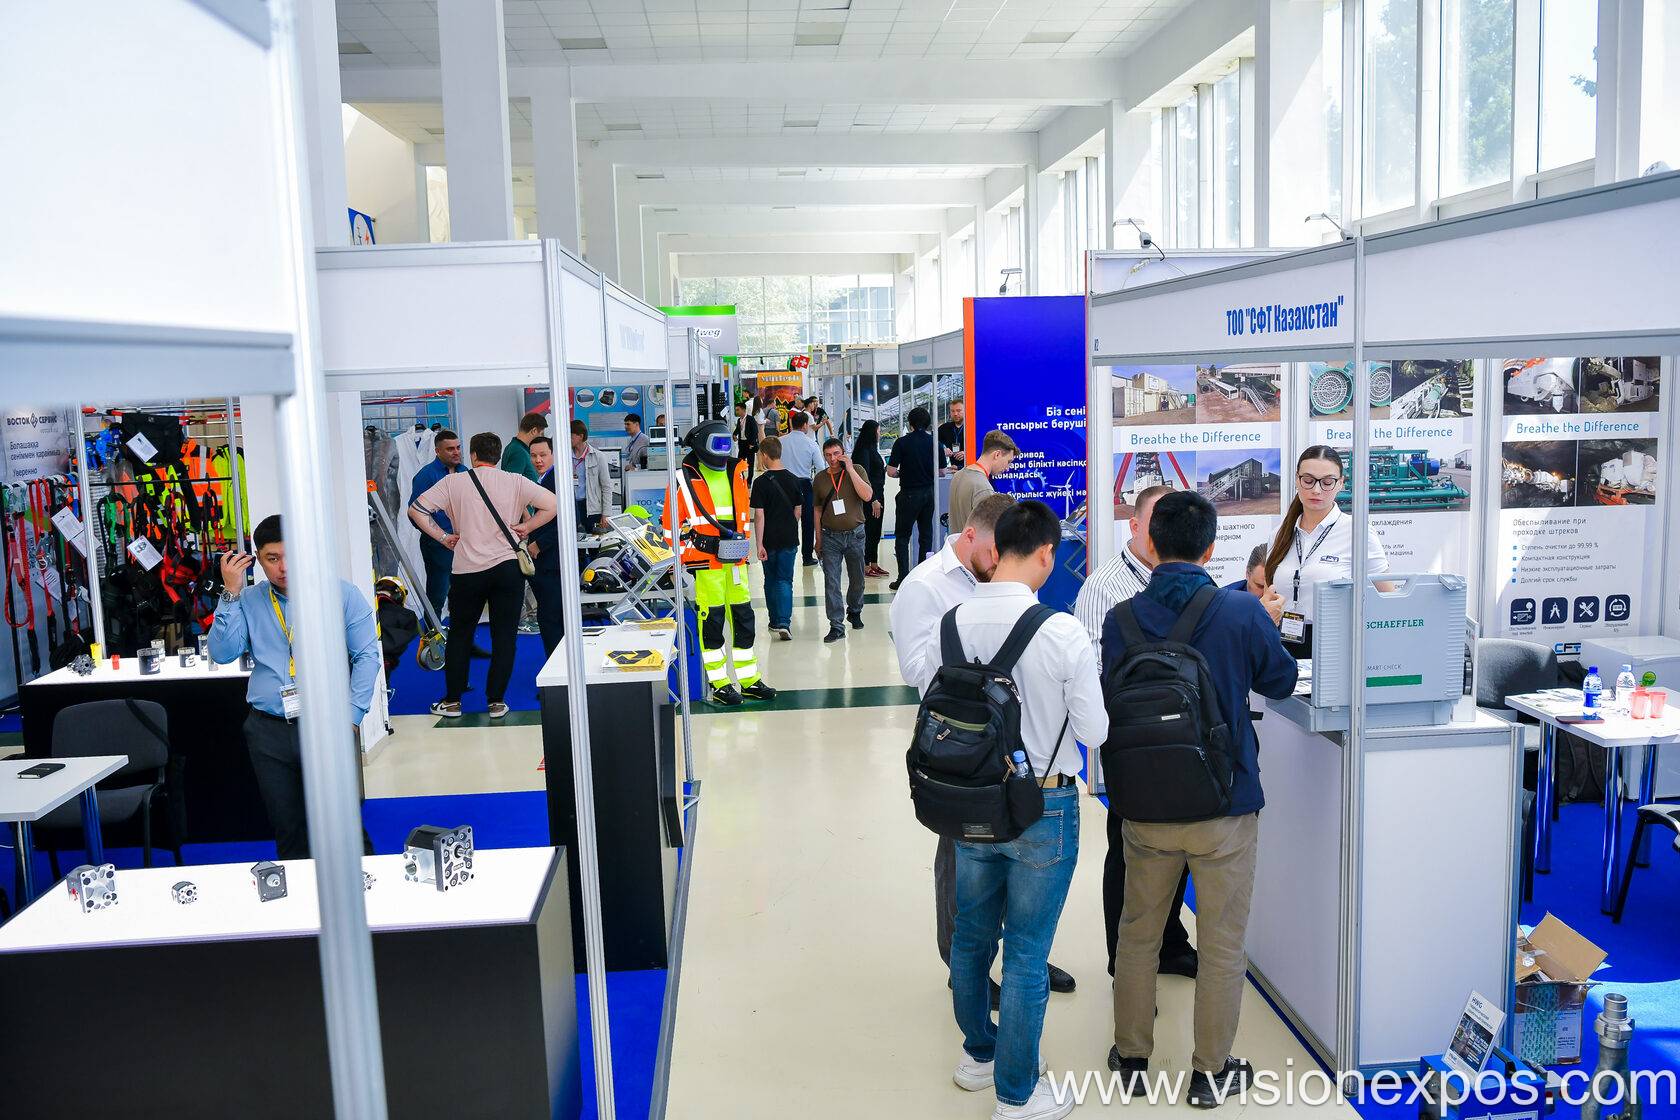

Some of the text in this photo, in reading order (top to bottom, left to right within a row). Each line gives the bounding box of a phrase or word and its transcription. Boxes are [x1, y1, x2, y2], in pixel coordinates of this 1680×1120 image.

[1226, 295, 1345, 336] ТОО "СФТ Казахстан"
[1046, 406, 1062, 417] Біз
[7, 415, 58, 426] ВОСТОК СЕРВИС
[996, 421, 1048, 432] тапсырыс
[1326, 426, 1453, 440] Brea the Difference
[1516, 420, 1640, 434] Breathe the Difference
[1131, 430, 1261, 445] Breathe the Difference
[1572, 518, 1587, 526] при
[1548, 528, 1579, 536] штреков
[1554, 642, 1582, 655] CFT
